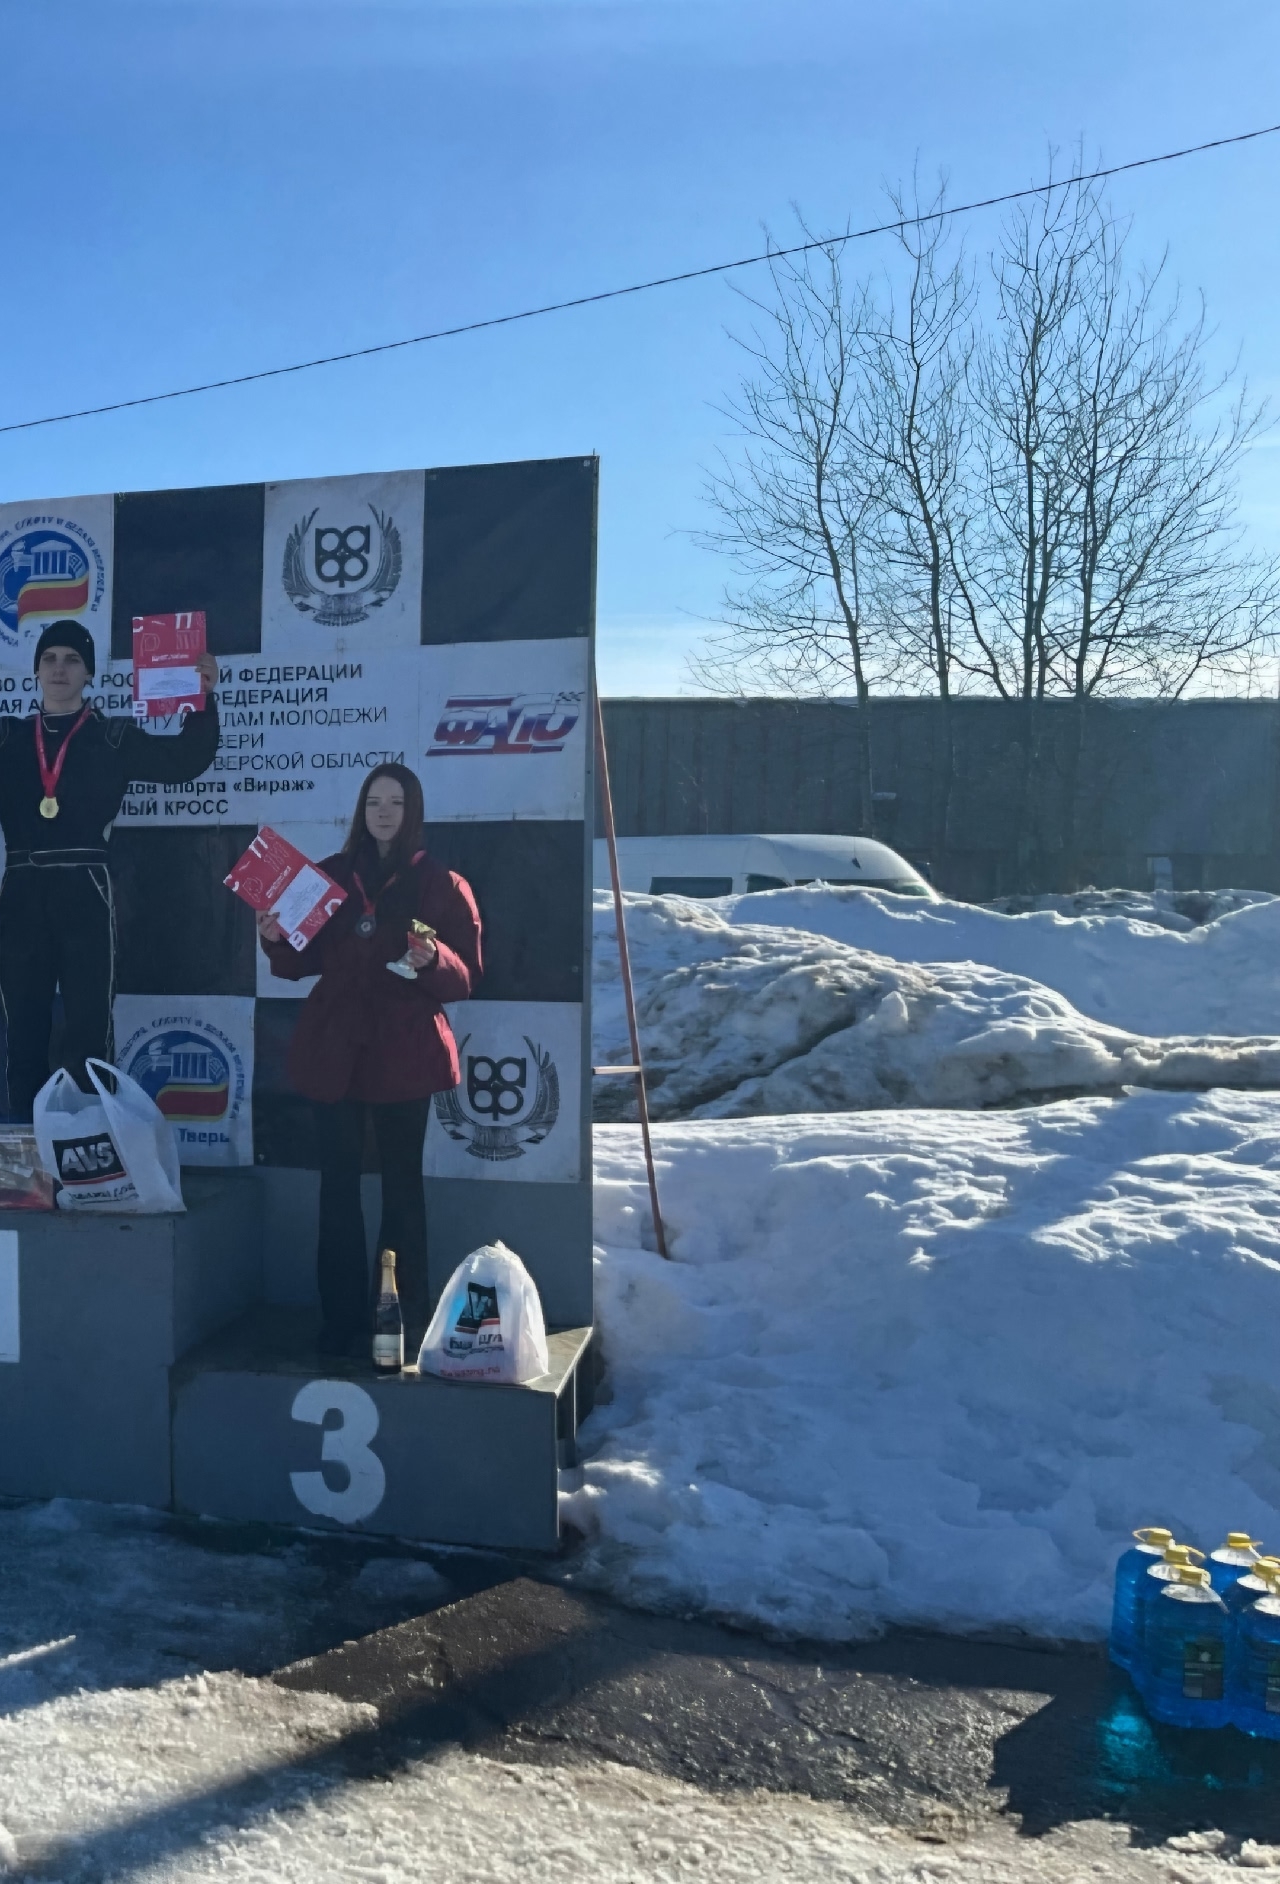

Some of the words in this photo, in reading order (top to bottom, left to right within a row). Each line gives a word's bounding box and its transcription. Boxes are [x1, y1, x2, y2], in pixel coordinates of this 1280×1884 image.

[238, 663, 363, 685] ФЕДЕРАЦИИ
[219, 710, 265, 727] ЛАМ
[270, 706, 388, 727] МОЛОДЕЖИ
[213, 751, 305, 771] ВЕРСКОЙ
[310, 750, 406, 769] ОБЛАСТИ
[125, 781, 157, 796] дов
[233, 777, 316, 795] «Вираж»
[164, 799, 229, 817] КРОСС
[178, 1128, 230, 1146] Тверь
[61, 1141, 115, 1173] AVS
[289, 1379, 387, 1524] 3
